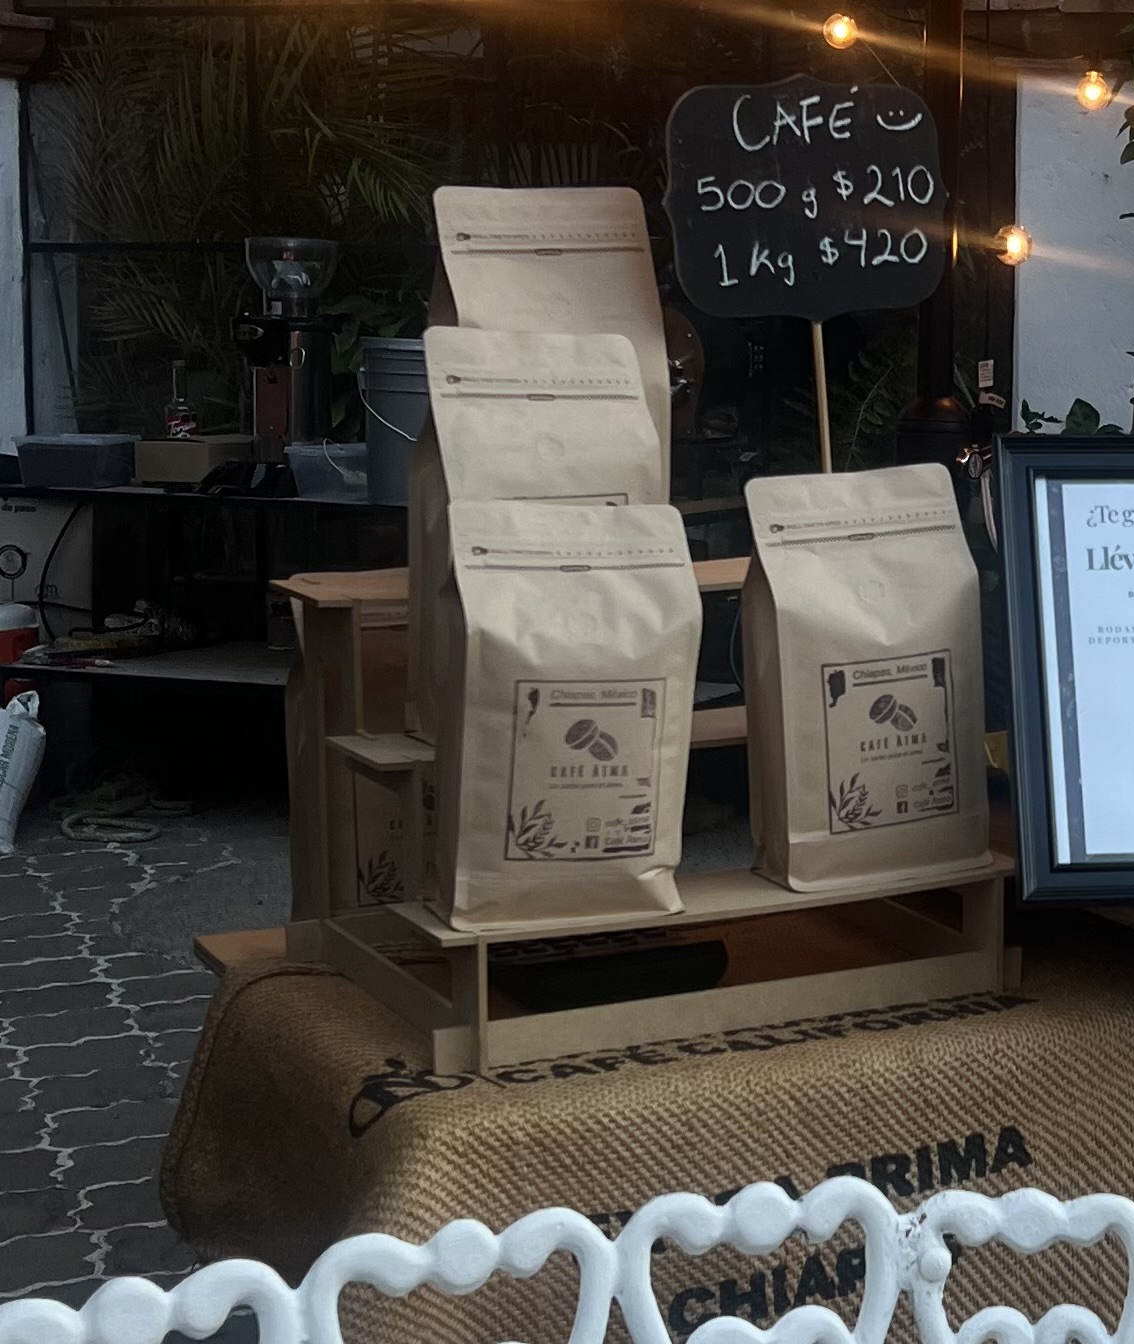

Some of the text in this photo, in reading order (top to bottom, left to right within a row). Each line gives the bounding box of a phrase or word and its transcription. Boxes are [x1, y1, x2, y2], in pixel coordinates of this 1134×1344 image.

[732, 86, 859, 151] CAFÉ
[697, 164, 934, 219] 500 g $210
[819, 227, 928, 268] $420
[1086, 504, 1119, 528] ¿Te
